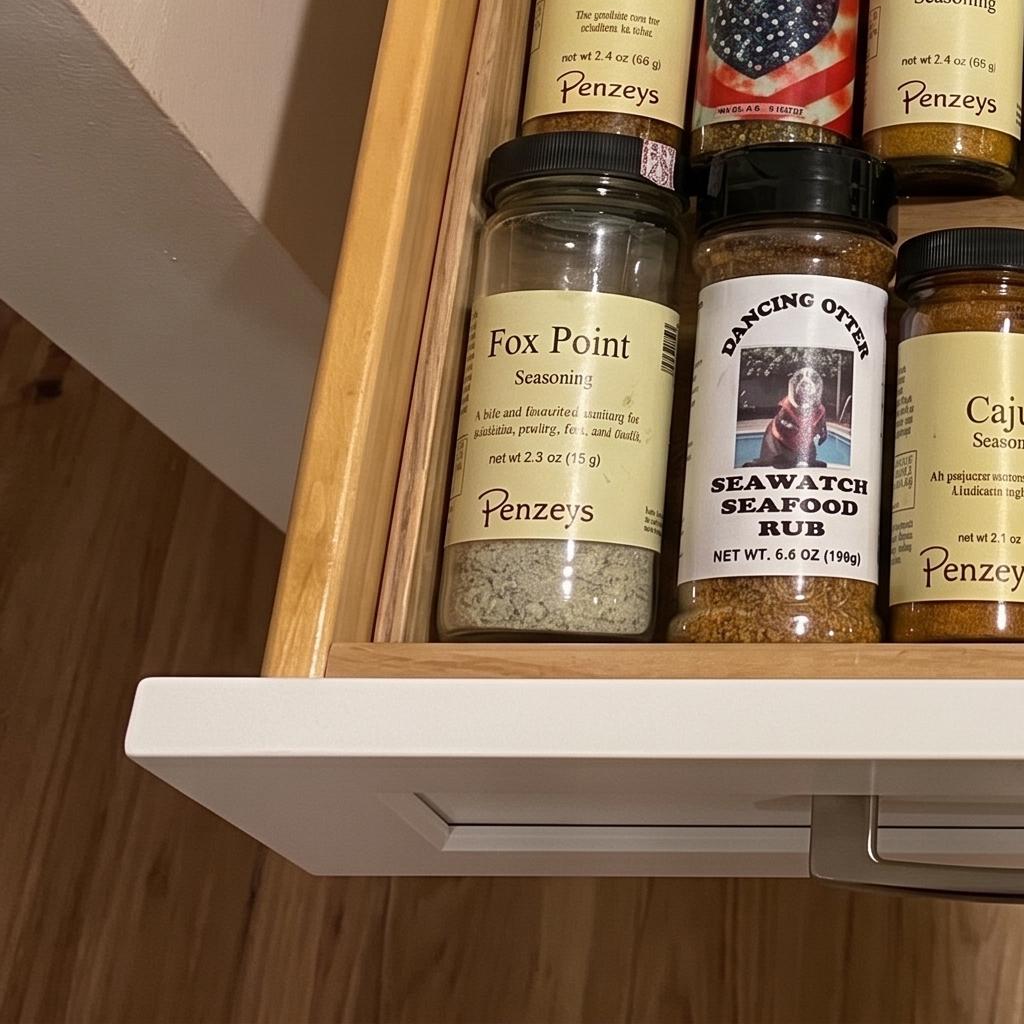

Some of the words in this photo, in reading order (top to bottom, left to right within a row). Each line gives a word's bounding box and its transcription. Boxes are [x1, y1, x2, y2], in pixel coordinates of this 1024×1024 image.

[616, 54, 629, 63] oz
[652, 59, 661, 71] g)
[920, 57, 932, 65] wt
[954, 58, 966, 66] oz
[557, 71, 659, 106] Penzeys
[898, 80, 997, 116] Penzeys
[722, 293, 814, 357] DANCING
[821, 298, 869, 360] OTTER
[488, 329, 539, 358] Fox
[549, 326, 631, 359] Point
[514, 370, 593, 390] Seasoning
[503, 408, 521, 418] and
[489, 453, 506, 465] net
[509, 452, 521, 462] wt
[524, 451, 543, 462] 2.3
[547, 454, 562, 463] oz
[566, 453, 585, 466] (15
[589, 454, 601, 468] g)
[711, 474, 868, 495] SEAWATCH
[478, 488, 594, 530] Penzeys
[721, 498, 858, 516] SEAFOOD
[758, 521, 825, 536] RUB
[958, 533, 974, 542] net
[977, 534, 988, 542] wt
[991, 533, 1006, 543] 2.1
[1010, 536, 1021, 544] oz
[714, 549, 740, 563] NET
[745, 548, 770, 561] WT.
[776, 549, 796, 560] 6.6
[801, 550, 820, 561] OZ
